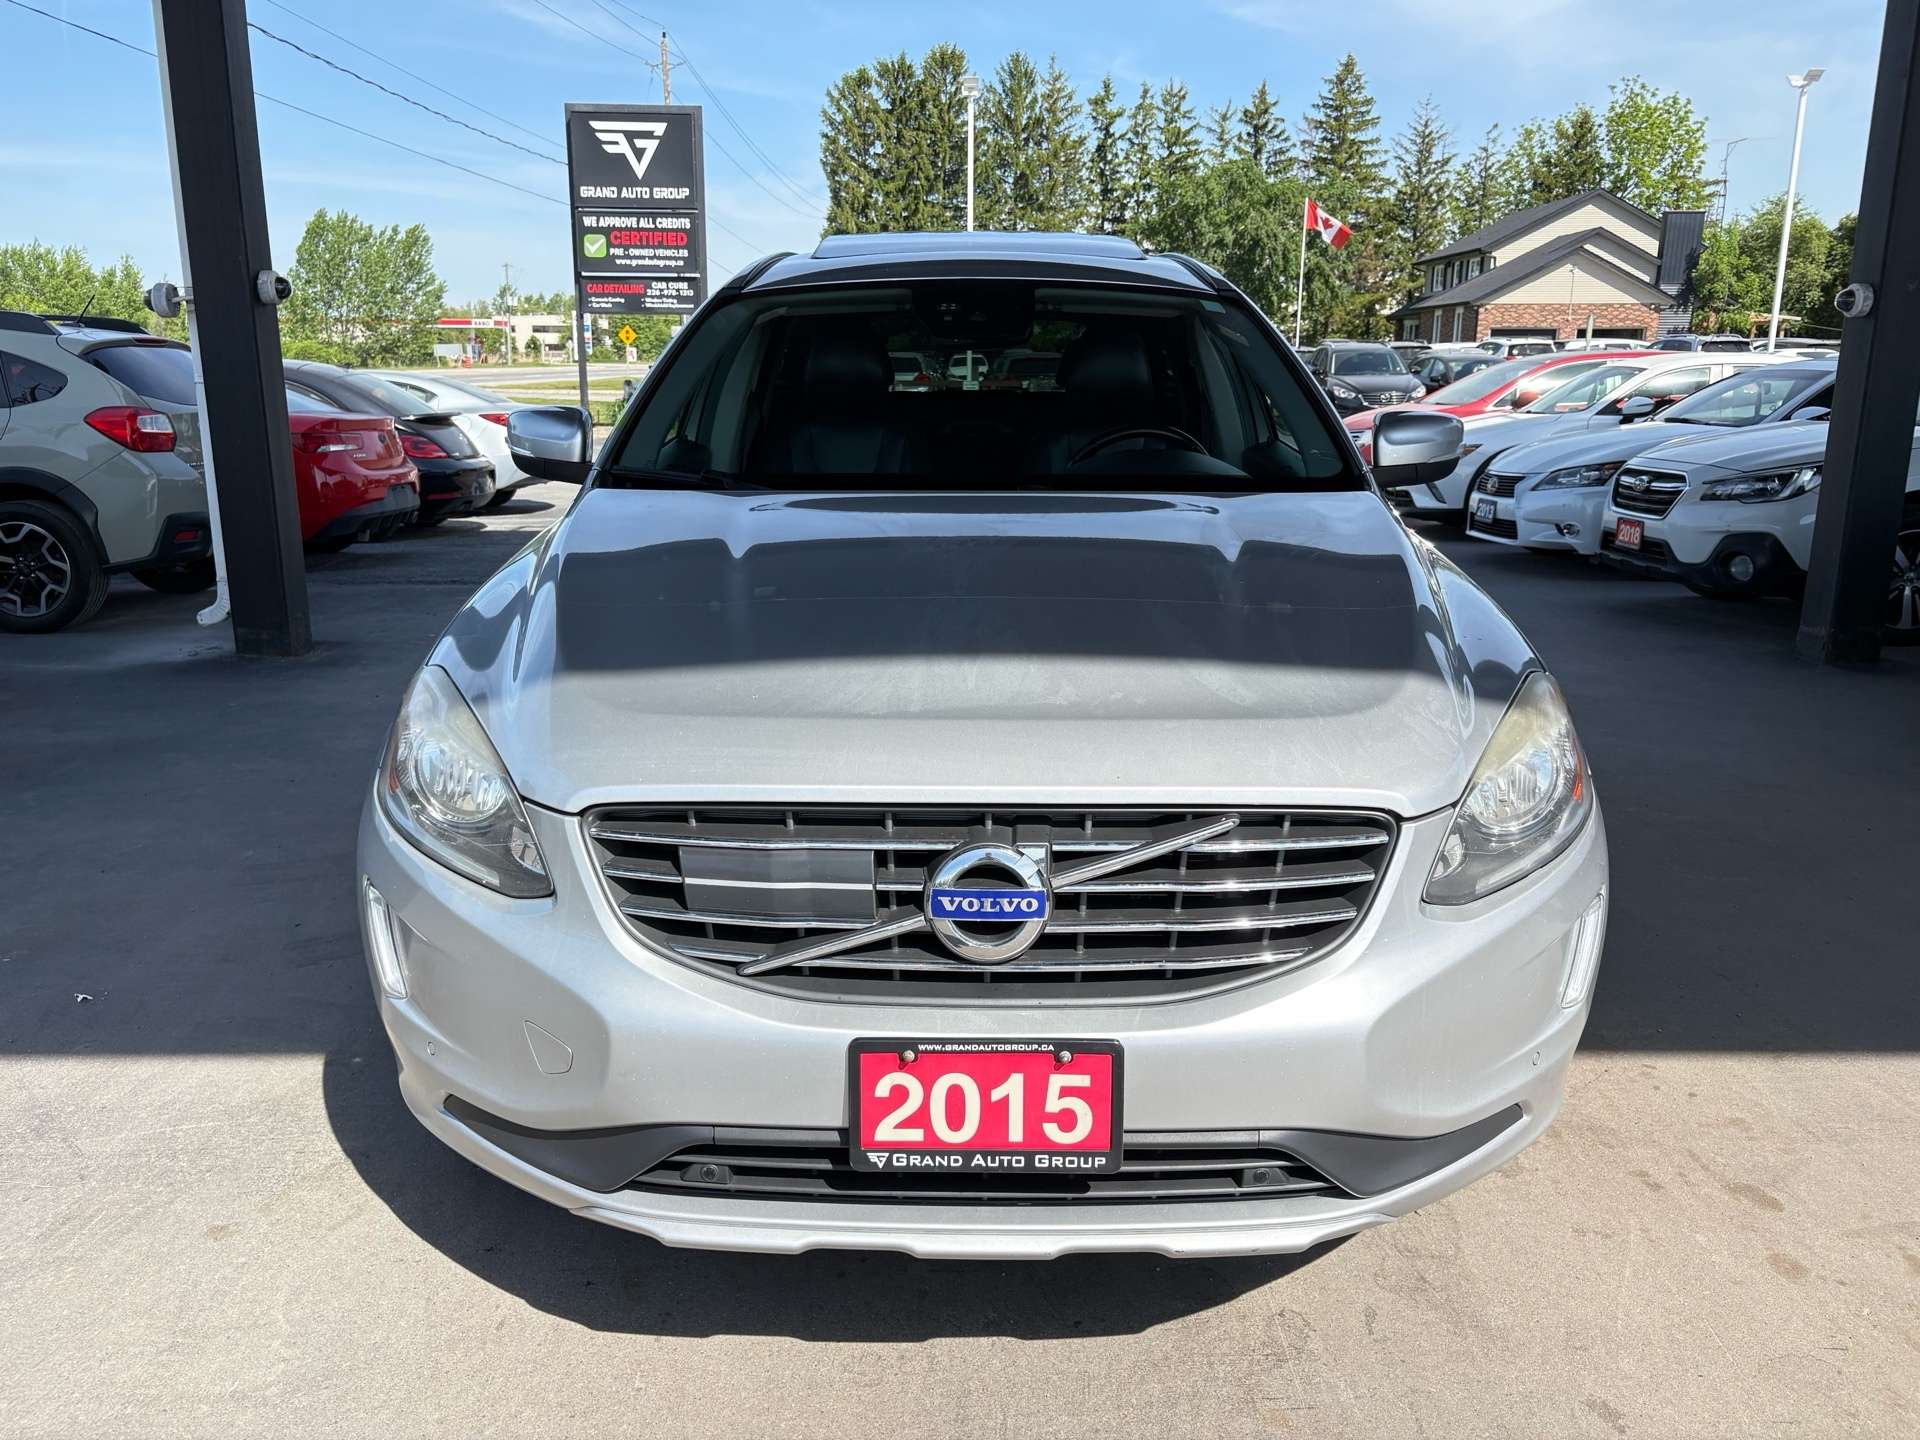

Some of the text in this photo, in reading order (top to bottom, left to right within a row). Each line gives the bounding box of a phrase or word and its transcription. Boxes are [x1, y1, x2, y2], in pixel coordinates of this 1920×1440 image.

[580, 186, 690, 199] GRAND AUTO GROUP
[583, 216, 691, 229] WE APPROVE ALL CREDITS
[610, 230, 688, 245] CERTIFIED
[629, 248, 655, 257] OWNED
[655, 249, 689, 257] VEHICLES
[587, 284, 645, 294] CAR DETAILING
[652, 281, 667, 289] CAR
[1619, 524, 1641, 545] 2018
[938, 896, 1039, 912] VOLVO
[918, 1044, 1054, 1052] WWW.GRANDAUTOGROUP.CA
[873, 1071, 1093, 1145] 2015
[892, 1153, 1106, 1169] GRAND AUTO GROUP
